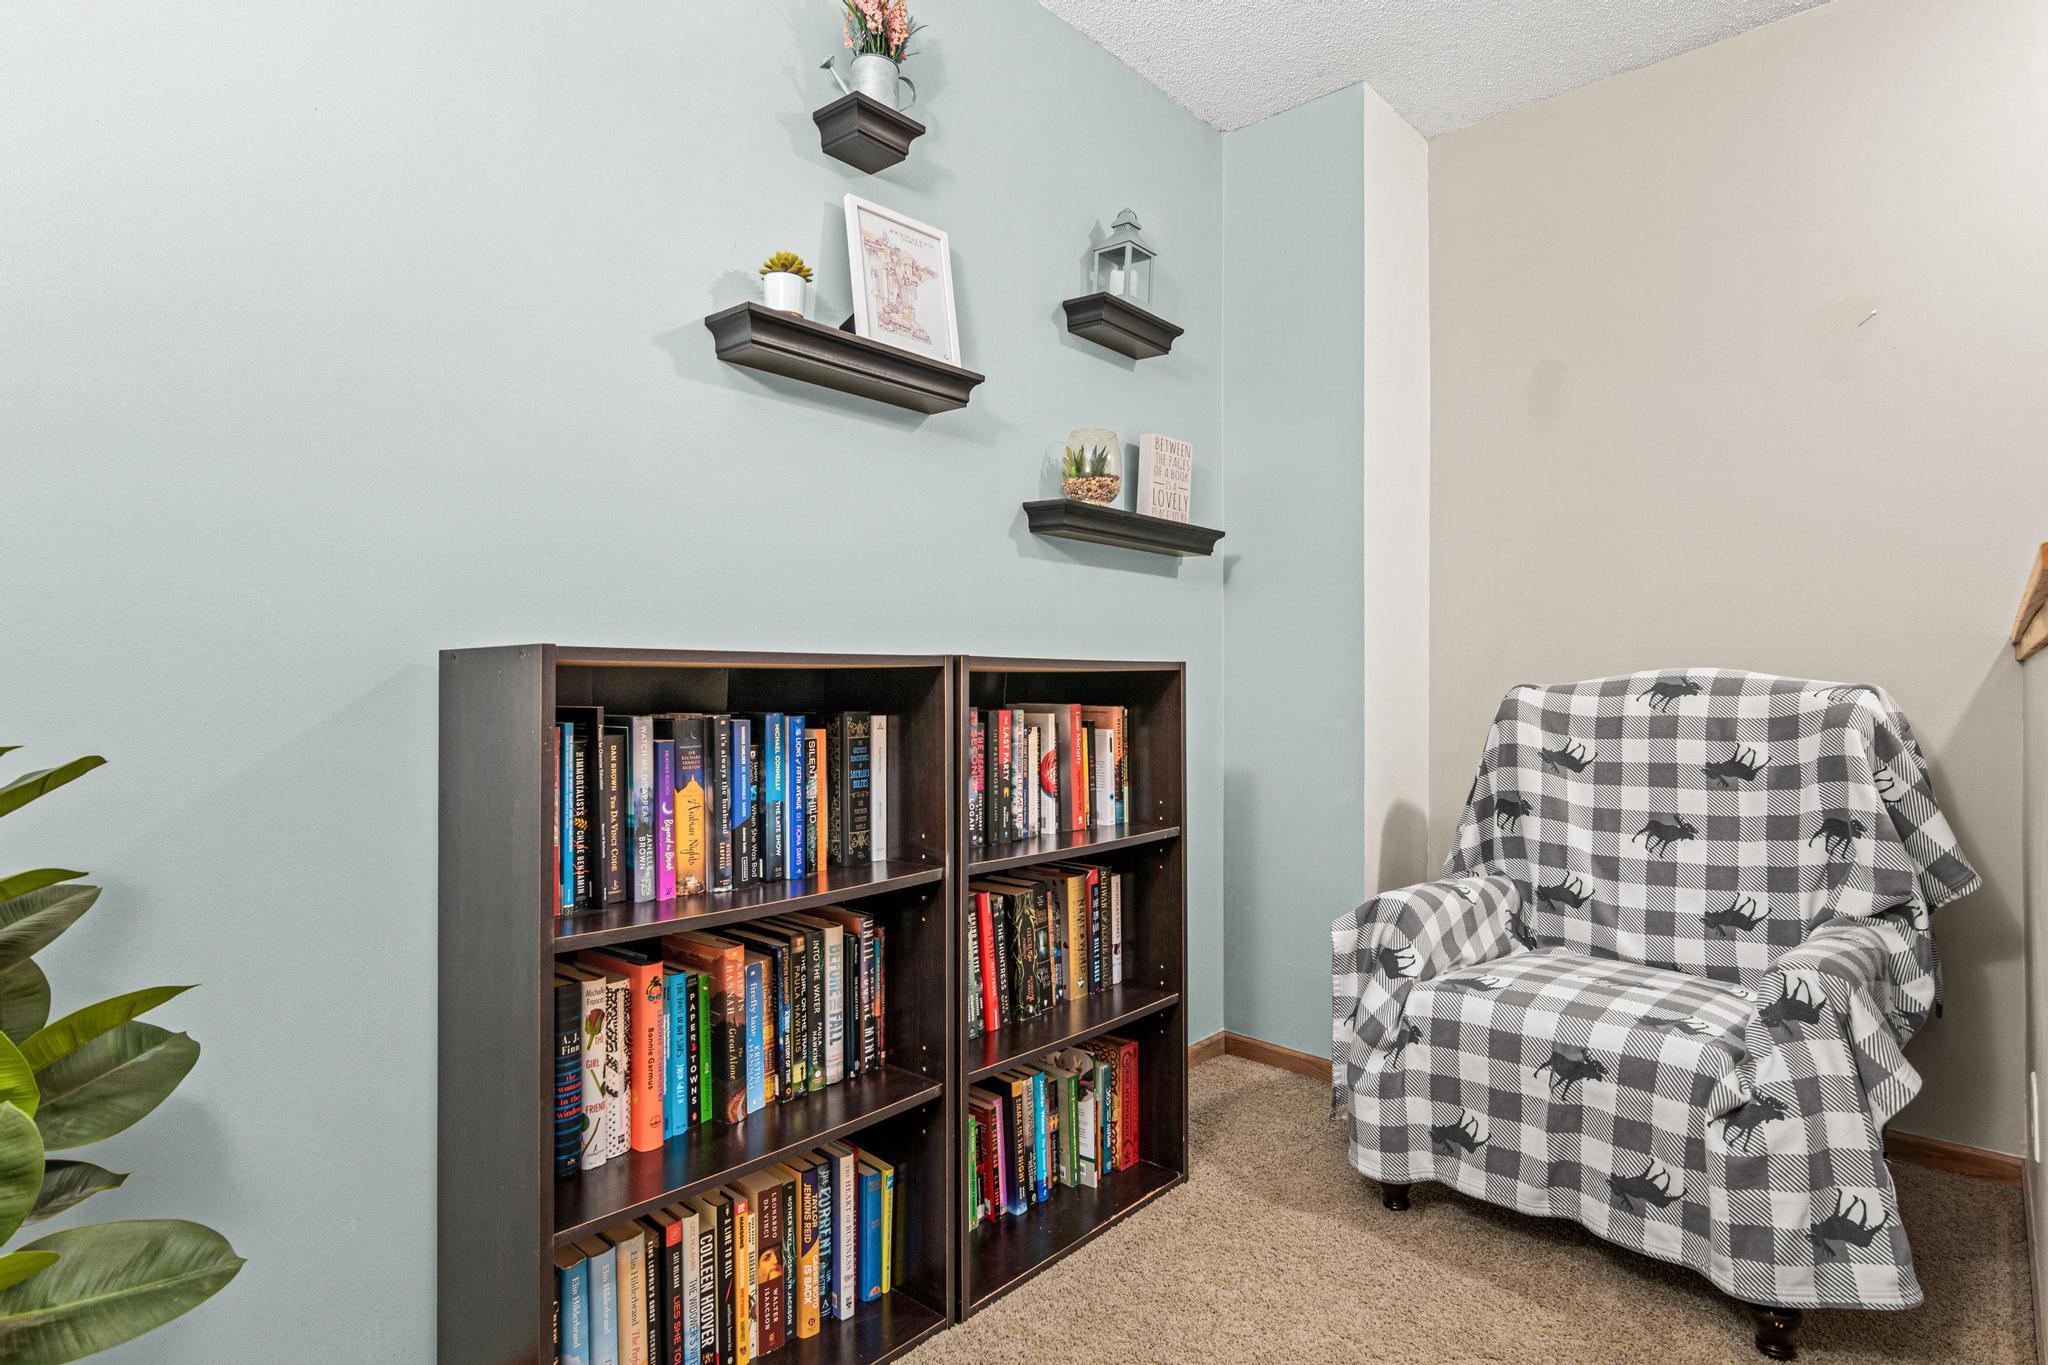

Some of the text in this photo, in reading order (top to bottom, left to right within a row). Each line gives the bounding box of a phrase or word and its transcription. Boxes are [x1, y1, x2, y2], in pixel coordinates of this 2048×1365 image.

[1154, 436, 1191, 458] BETWEEN
[1155, 451, 1191, 473] THE PAGES
[1153, 465, 1189, 483] OF A BOOK
[1173, 482, 1177, 491] A
[1152, 488, 1189, 513] LOVELY
[720, 733, 728, 747] it's
[808, 740, 816, 782] SILENT
[970, 730, 978, 792] SECONDS
[976, 729, 984, 751] THE
[1074, 732, 1082, 765] Moriarty
[609, 745, 618, 791] DAN BROWN
[640, 725, 649, 823] WATCH DISAPPEAR
[719, 749, 729, 779] always
[575, 758, 585, 816] IMMORTALISTS
[1017, 795, 1023, 809] ME
[680, 799, 702, 866] Arabian Nights
[721, 798, 729, 834] husband
[576, 830, 585, 894] CHLOE BENJAMIN
[610, 810, 619, 872] DA VINCI CODE
[638, 836, 646, 870] BROWN
[645, 833, 653, 871] JANELLE
[812, 940, 820, 962] INTO
[1076, 898, 1087, 974] NAME WIND
[676, 982, 684, 995] THE
[998, 945, 1007, 991] HUNTRESS
[726, 965, 734, 1016] HANNAH
[749, 982, 758, 1037] firefly lane
[801, 998, 807, 1011] ON
[829, 944, 842, 1046] BEFORE FALL
[863, 920, 875, 1069] UNTIL MINE.
[561, 1044, 580, 1056] Finn
[594, 1035, 604, 1045] THE
[647, 1027, 655, 1090] Bonnie Garmus
[728, 1028, 737, 1053] Great
[585, 1059, 600, 1069] GIRL
[689, 1056, 698, 1105] TOWNS
[585, 1101, 606, 1114] FRIEND
[763, 1199, 769, 1213] DA
[803, 1183, 812, 1244] JENKINS REID
[818, 1186, 832, 1257] CURRENT
[845, 1225, 853, 1272] BUSINESS
[602, 1264, 611, 1335] Elin Hilderbrand
[630, 1251, 640, 1326] Elin Hilderbrand
[699, 1234, 715, 1349] COLLEEN HOOVER
[804, 1265, 812, 1305] IS BACK
[571, 1276, 581, 1349] Elin Hilderbrand
[673, 1294, 682, 1345] LIES SHE
[688, 1278, 699, 1365] THE WIDOWER'S WIFE
[631, 1330, 640, 1345] The
